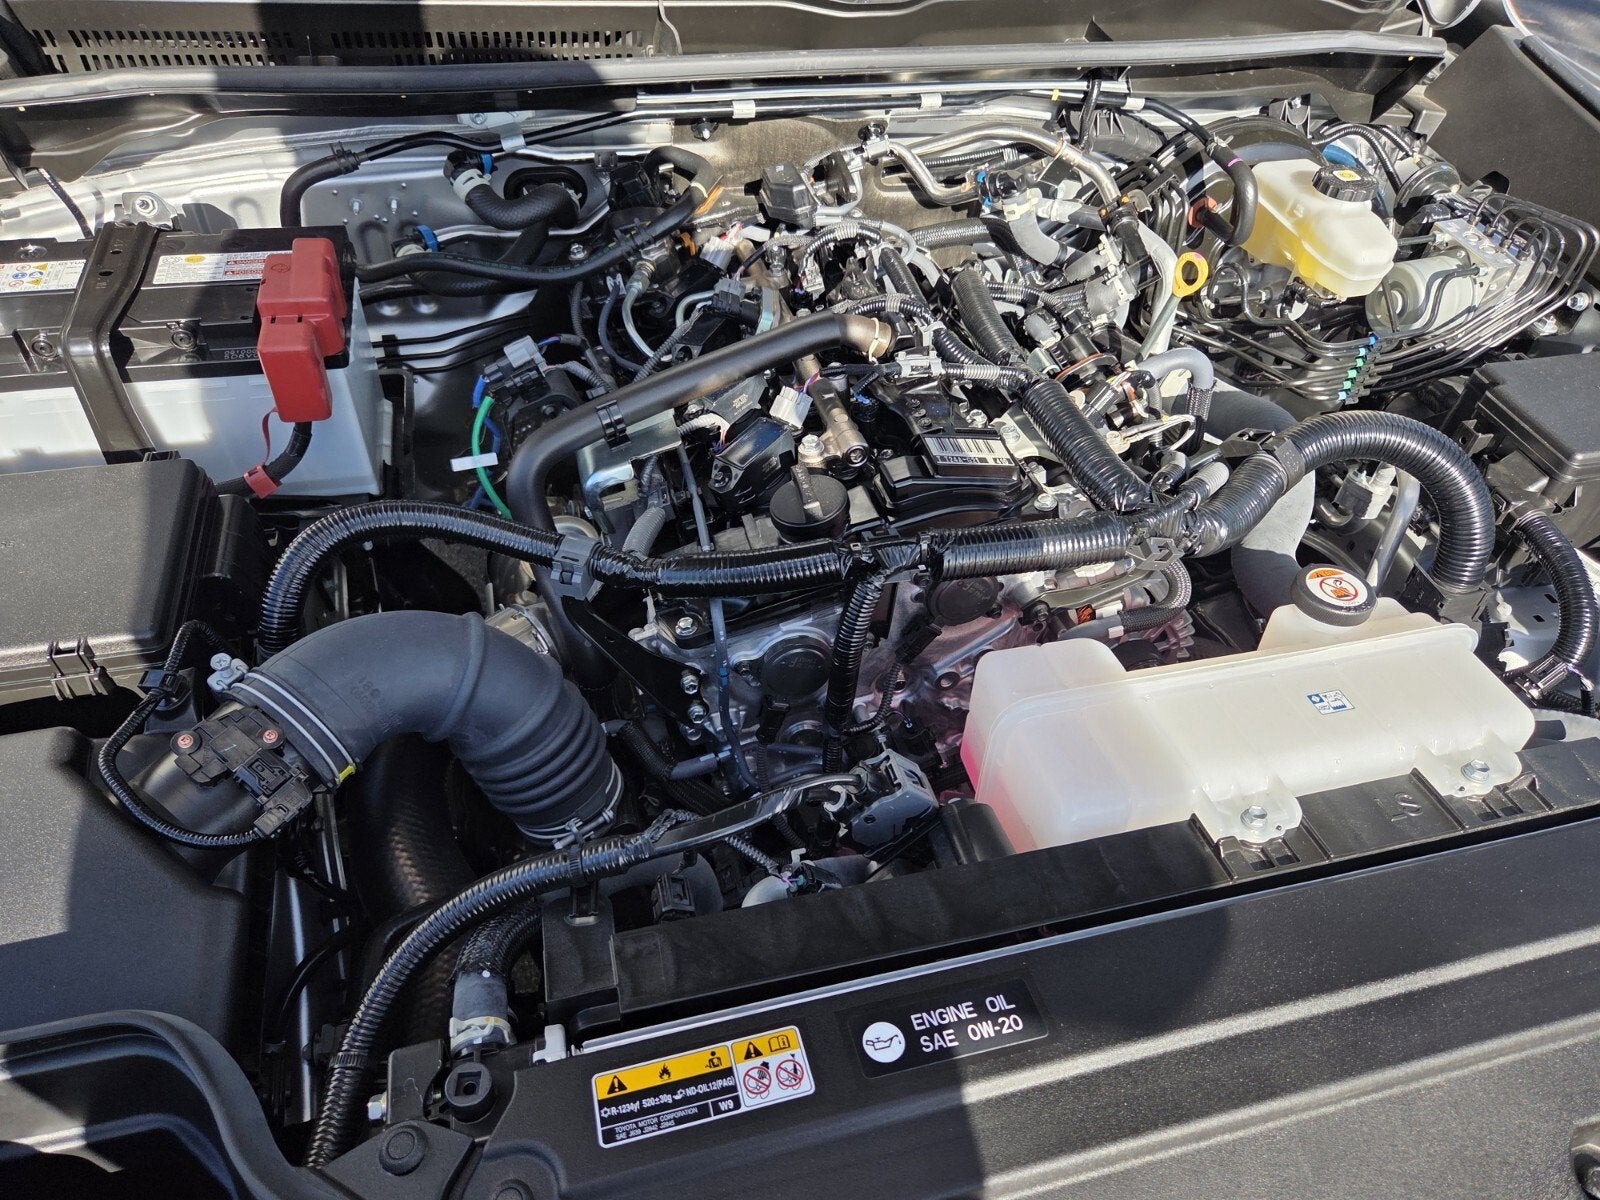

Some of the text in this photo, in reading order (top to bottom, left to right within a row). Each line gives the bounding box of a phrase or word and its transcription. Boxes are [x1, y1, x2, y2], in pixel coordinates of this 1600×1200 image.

[910, 994, 1016, 1031] ENGINE OIL
[920, 1014, 1024, 1052] SAE 0W-20
[718, 1100, 734, 1111] W9
[615, 1107, 698, 1133] TOYOTA MOTOR CORPORATION
[615, 1131, 627, 1140] SAE
